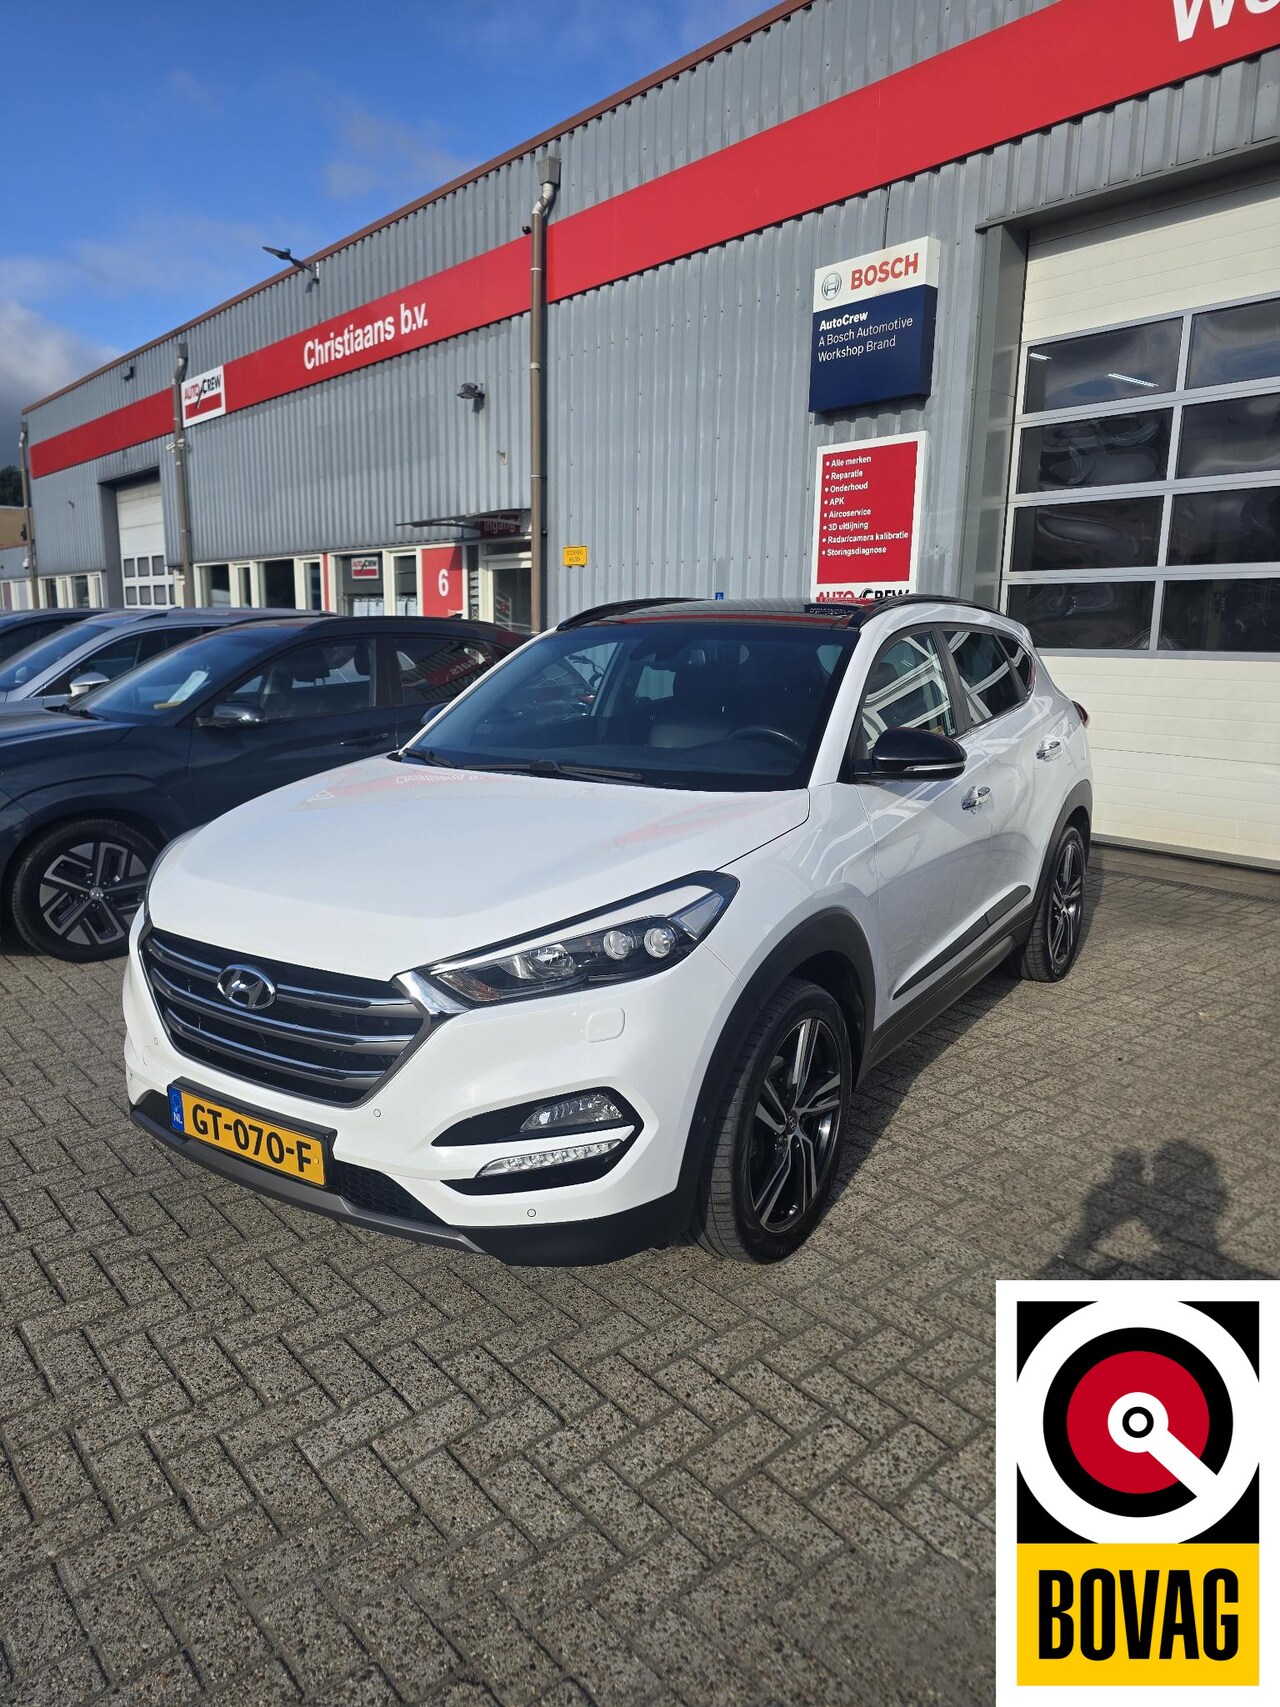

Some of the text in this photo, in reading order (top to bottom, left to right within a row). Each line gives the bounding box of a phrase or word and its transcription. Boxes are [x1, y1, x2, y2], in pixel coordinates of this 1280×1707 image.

[850, 252, 919, 291] BOSCH
[819, 311, 869, 332] AutoCrew
[303, 302, 429, 370] Christiaans b.v.
[818, 317, 914, 348] A Bosch Automotive
[818, 334, 897, 363] Workshop Brand
[831, 455, 872, 468] Alle merken
[830, 469, 864, 481] Reparatie
[830, 481, 869, 493] Onderhoud
[829, 497, 845, 506] APK
[828, 508, 872, 519] Aircoservice
[827, 521, 869, 532] 3D uitlijning
[875, 531, 909, 541] kalibratie
[827, 546, 887, 557] Storingsdiagnose
[438, 568, 450, 597] 6
[173, 1112, 183, 1125] NL
[192, 1103, 312, 1173] GT-070-F
